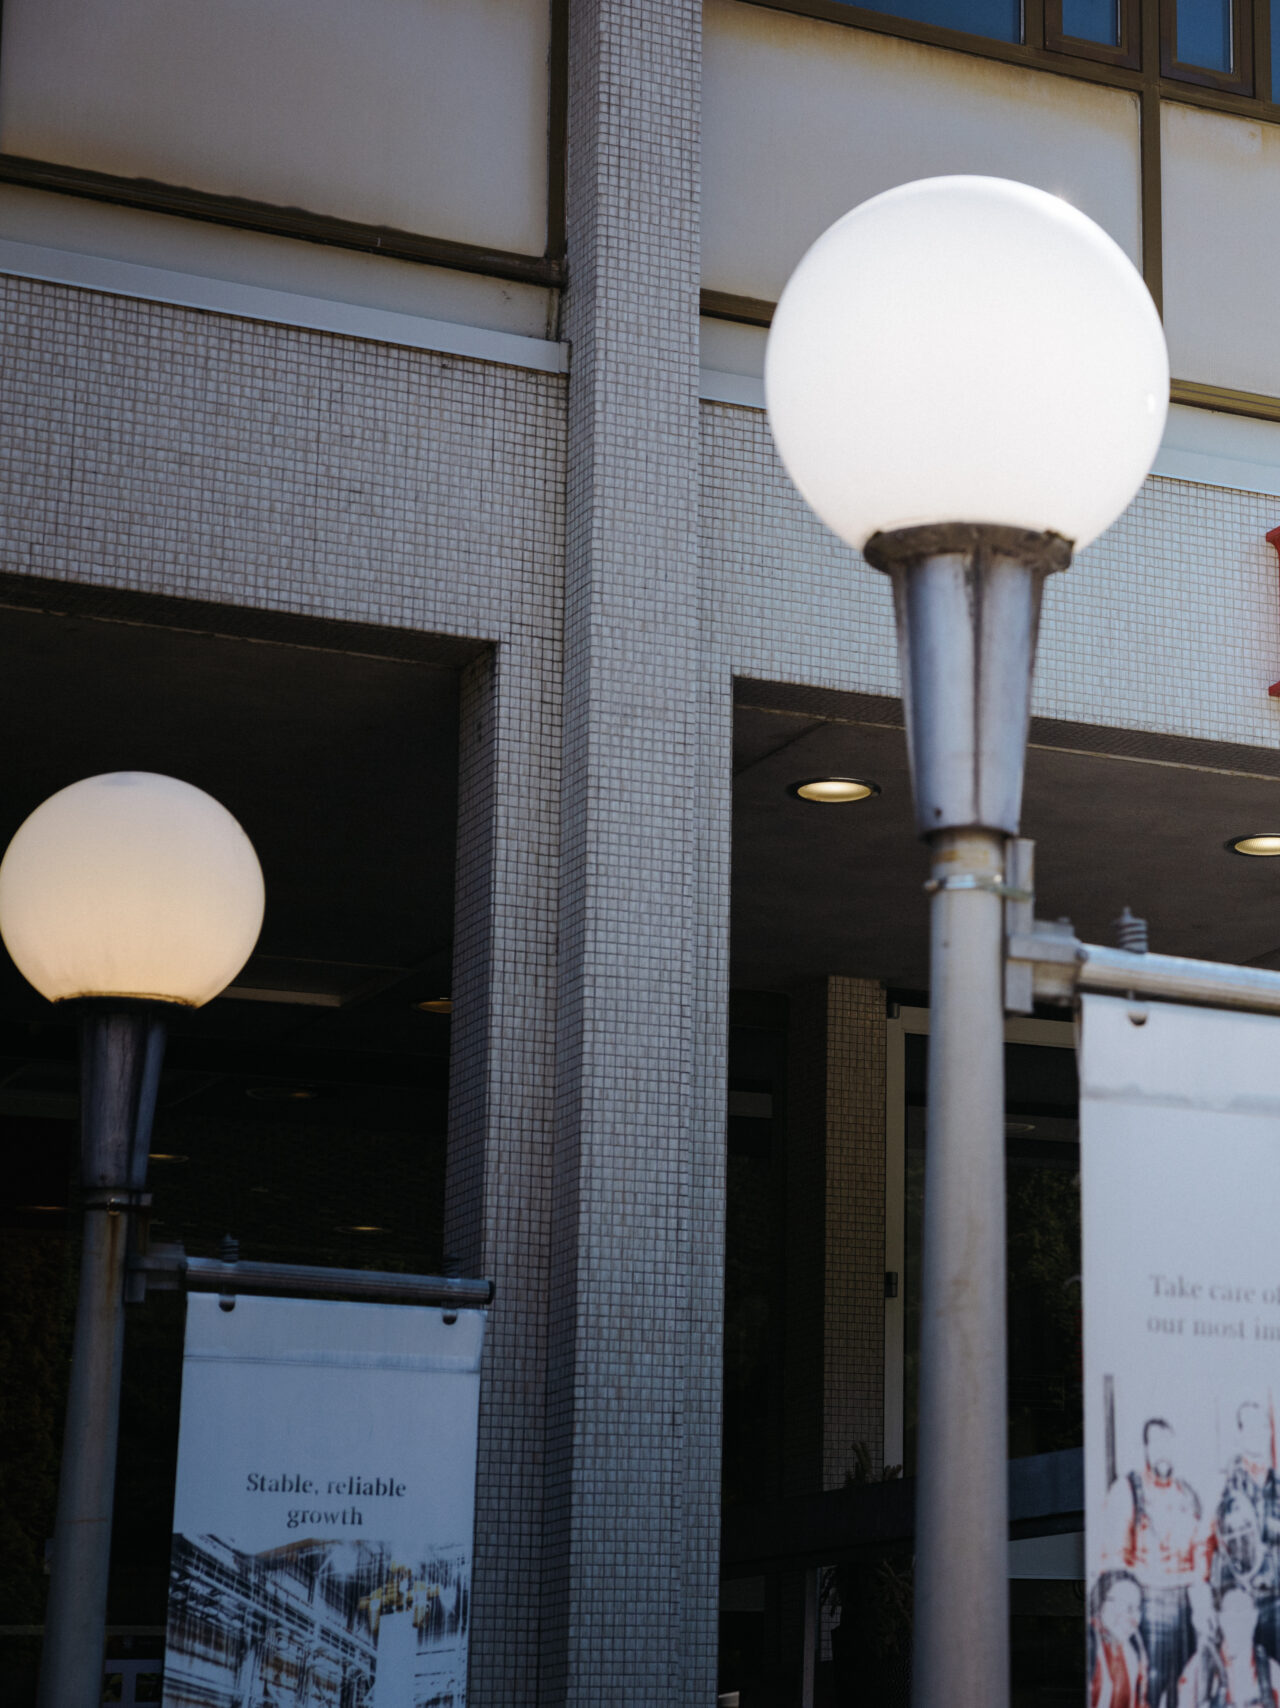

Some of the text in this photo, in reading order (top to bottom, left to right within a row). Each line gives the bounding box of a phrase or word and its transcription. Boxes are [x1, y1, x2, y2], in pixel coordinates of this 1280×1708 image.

[1150, 1275, 1203, 1299] Take
[1209, 1284, 1256, 1302] care
[1147, 1313, 1185, 1335] our
[1193, 1318, 1246, 1340] most
[246, 1472, 407, 1497] Stable, reliable
[286, 1506, 363, 1529] growth
